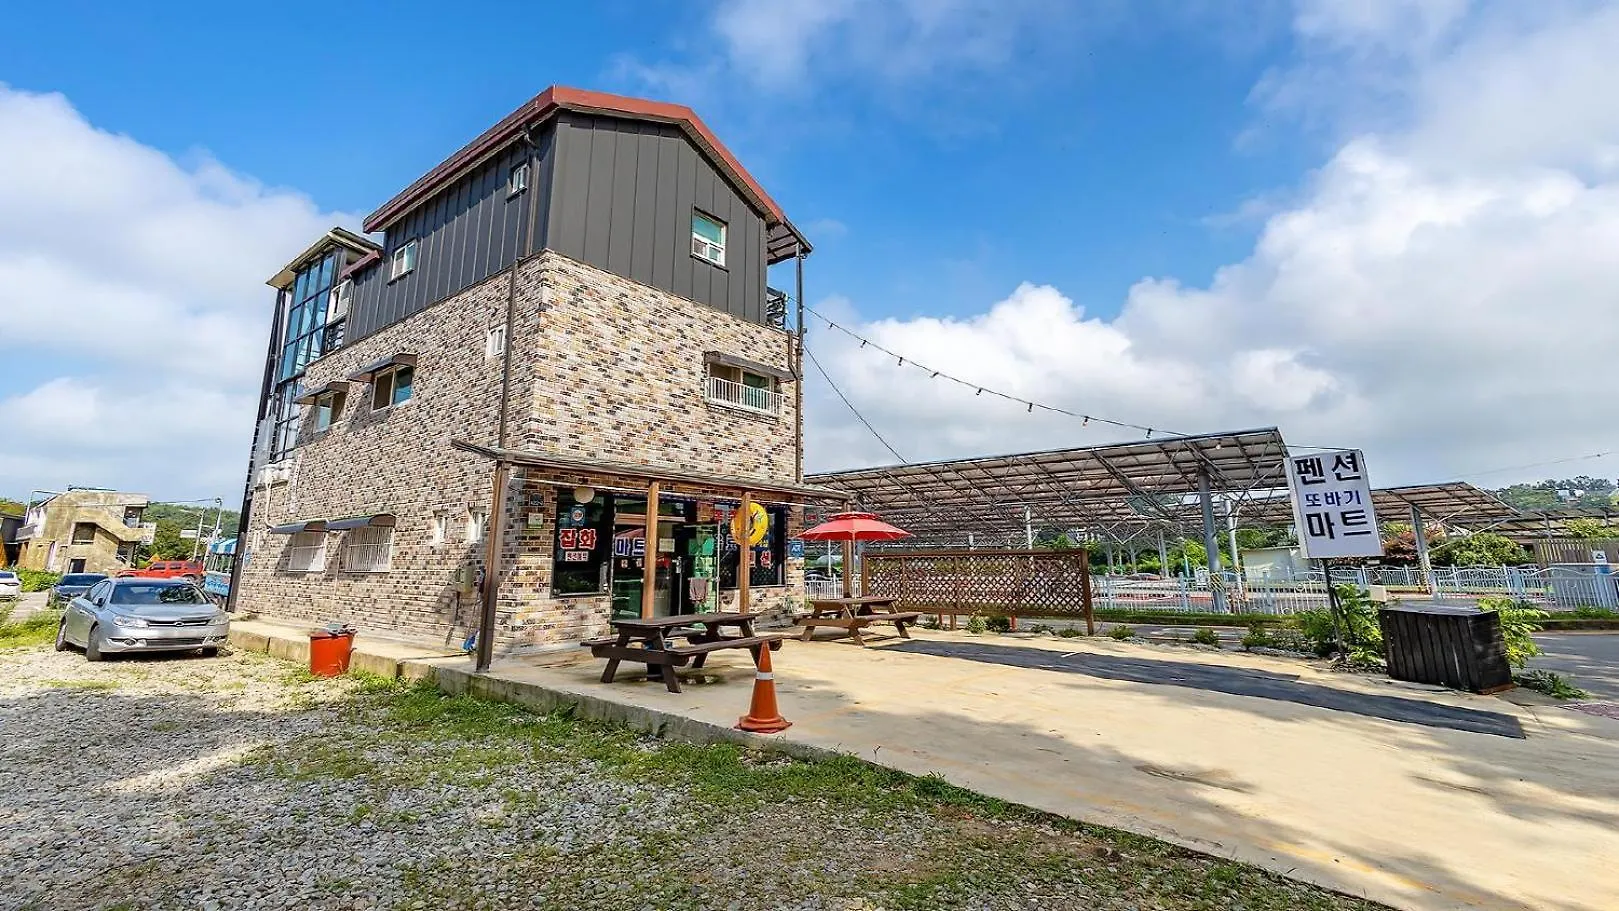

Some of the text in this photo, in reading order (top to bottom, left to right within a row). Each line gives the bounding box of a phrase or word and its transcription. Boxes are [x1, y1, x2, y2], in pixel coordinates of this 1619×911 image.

[1294, 452, 1362, 486] 펜션
[1304, 490, 1362, 507] 또바기
[1305, 509, 1372, 540] 마트
[559, 528, 597, 550] 잡화
